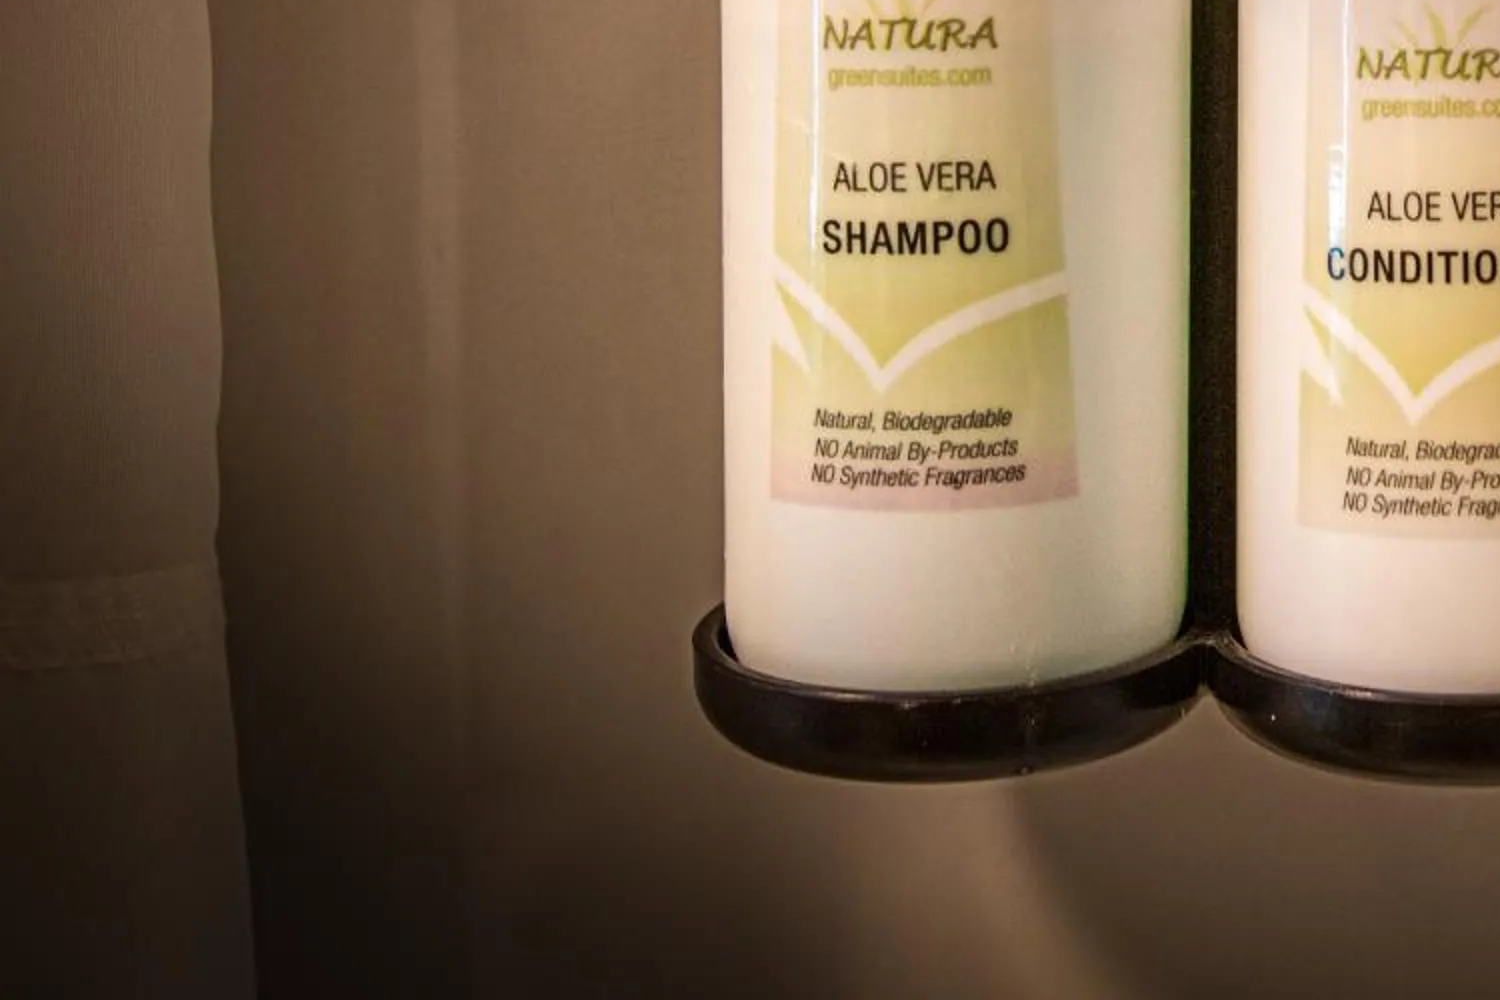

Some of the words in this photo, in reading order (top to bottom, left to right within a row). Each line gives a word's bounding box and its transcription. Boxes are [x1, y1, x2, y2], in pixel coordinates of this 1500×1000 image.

[822, 15, 999, 51] NATURA
[828, 66, 992, 89] greensuites.com
[834, 162, 906, 192] ALOE
[916, 160, 997, 191] VERA
[1368, 191, 1441, 221] ALOE
[822, 217, 1009, 255] SHAMPOO
[813, 408, 876, 432] Natural,
[882, 408, 1012, 434] Biodegradable
[815, 439, 839, 458] NO
[842, 440, 901, 461] Animal
[908, 438, 1018, 464] By-Products
[1346, 437, 1409, 461] Natural,
[811, 464, 835, 483] NO
[839, 468, 919, 491] Synthetic
[924, 463, 1026, 490] Fragrances
[1347, 467, 1371, 486] NO
[1374, 469, 1434, 489] Animal
[1343, 492, 1366, 512] NO
[1372, 496, 1452, 519] Synthetic
